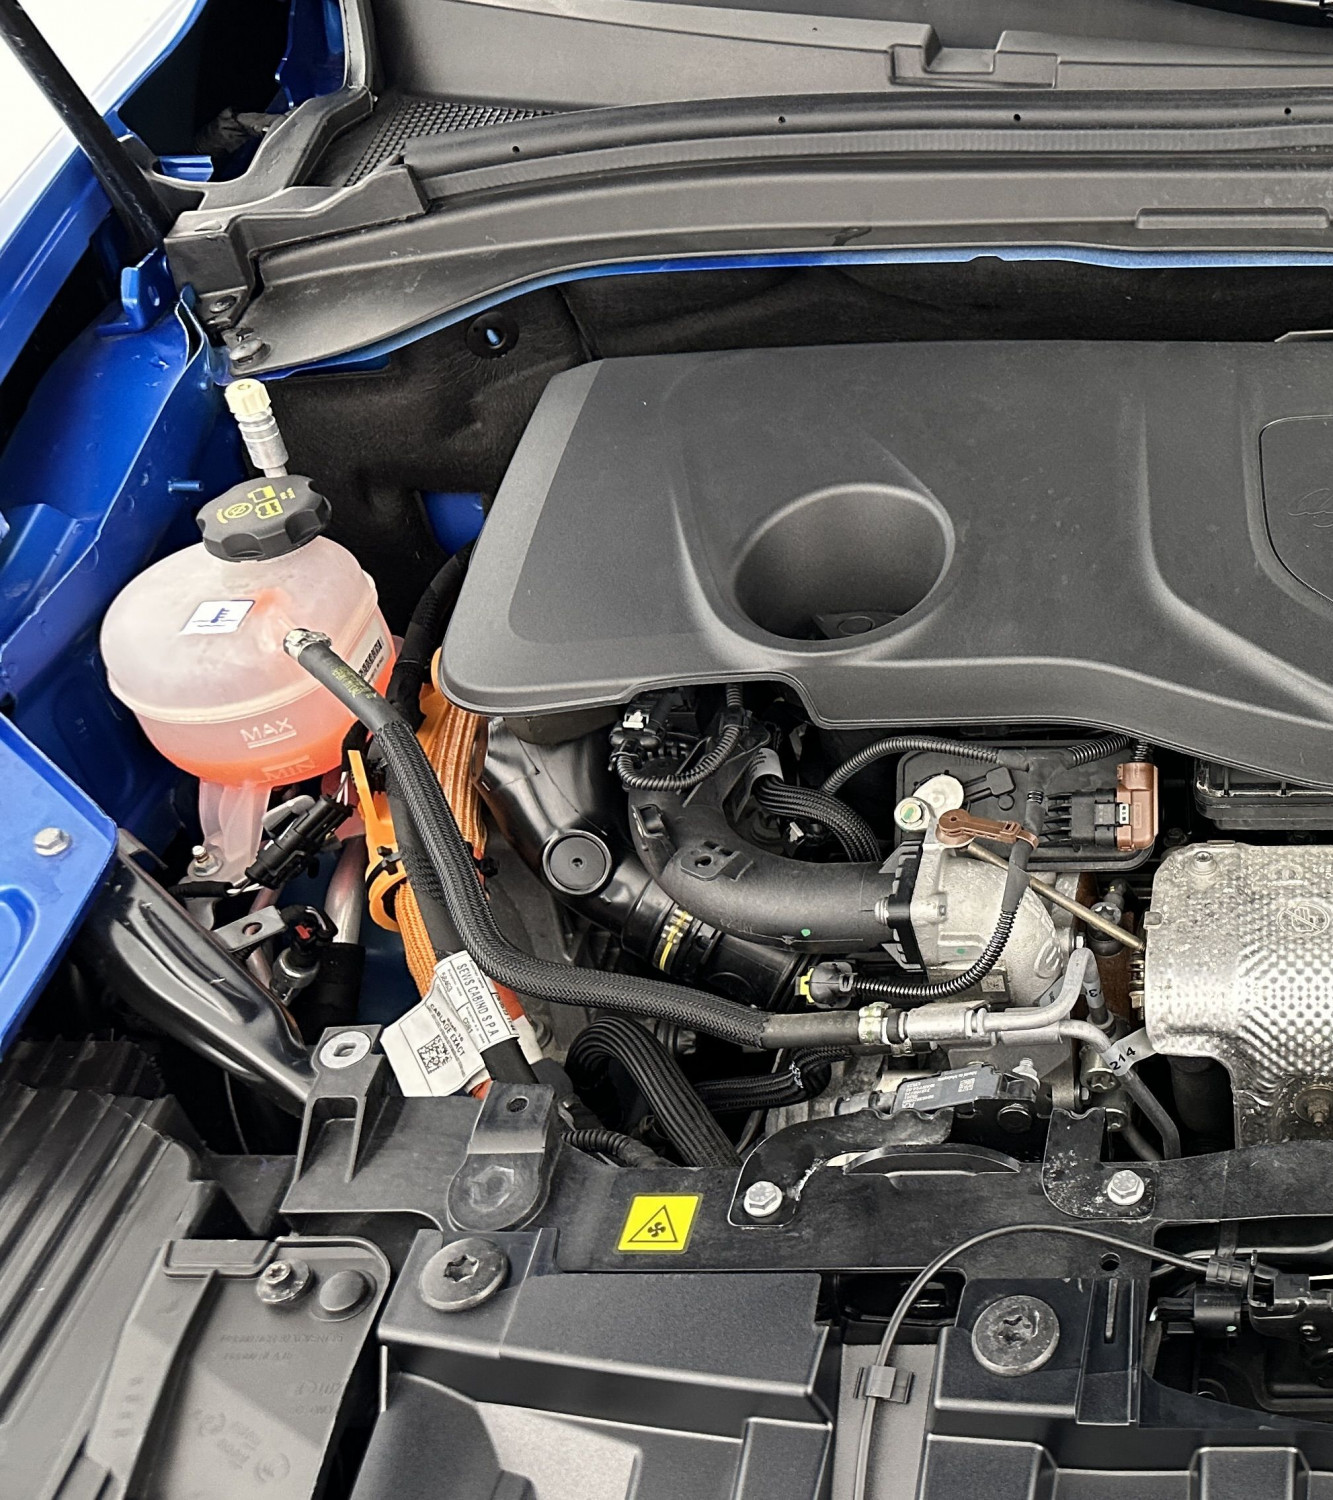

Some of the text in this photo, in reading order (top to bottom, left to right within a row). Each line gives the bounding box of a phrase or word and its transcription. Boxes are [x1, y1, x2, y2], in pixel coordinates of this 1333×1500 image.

[240, 718, 293, 741] MAX
[265, 760, 316, 781] MIN
[456, 963, 474, 987] SEWS
[450, 1032, 466, 1056] EXACT
[1109, 1046, 1136, 1070] 214
